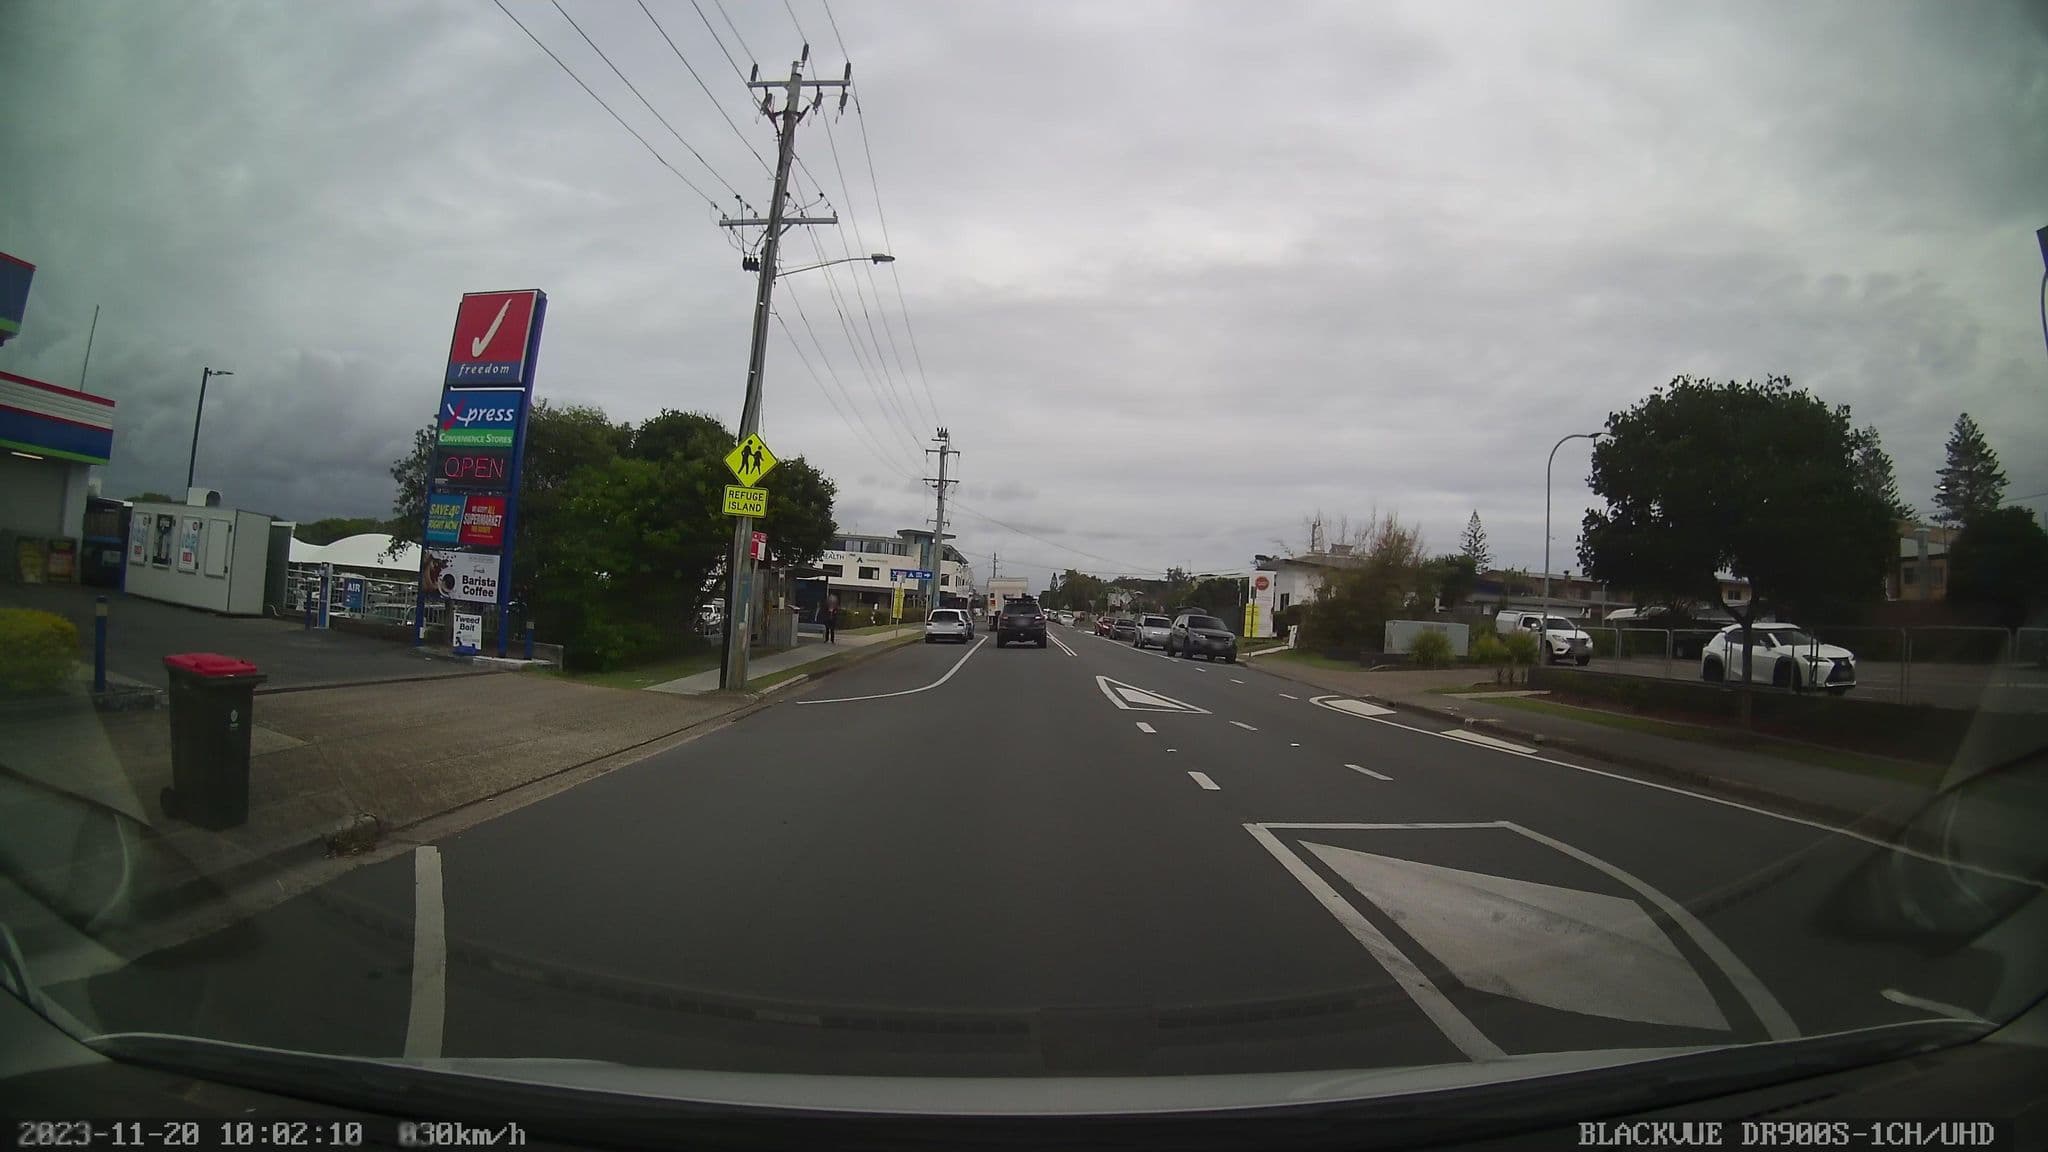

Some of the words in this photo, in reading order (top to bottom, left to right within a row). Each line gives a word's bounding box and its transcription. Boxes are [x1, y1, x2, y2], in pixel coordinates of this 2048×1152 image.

[459, 363, 510, 377] freedom
[445, 457, 504, 478] OPEN
[728, 491, 764, 502] REFUGE
[728, 502, 762, 512] ISLAND
[463, 513, 502, 527] SUPERMARKET
[462, 575, 496, 587] Barista
[347, 583, 360, 592] AIR
[463, 585, 494, 597] Coffee
[455, 615, 480, 624] Tweed
[459, 623, 475, 632] Bait
